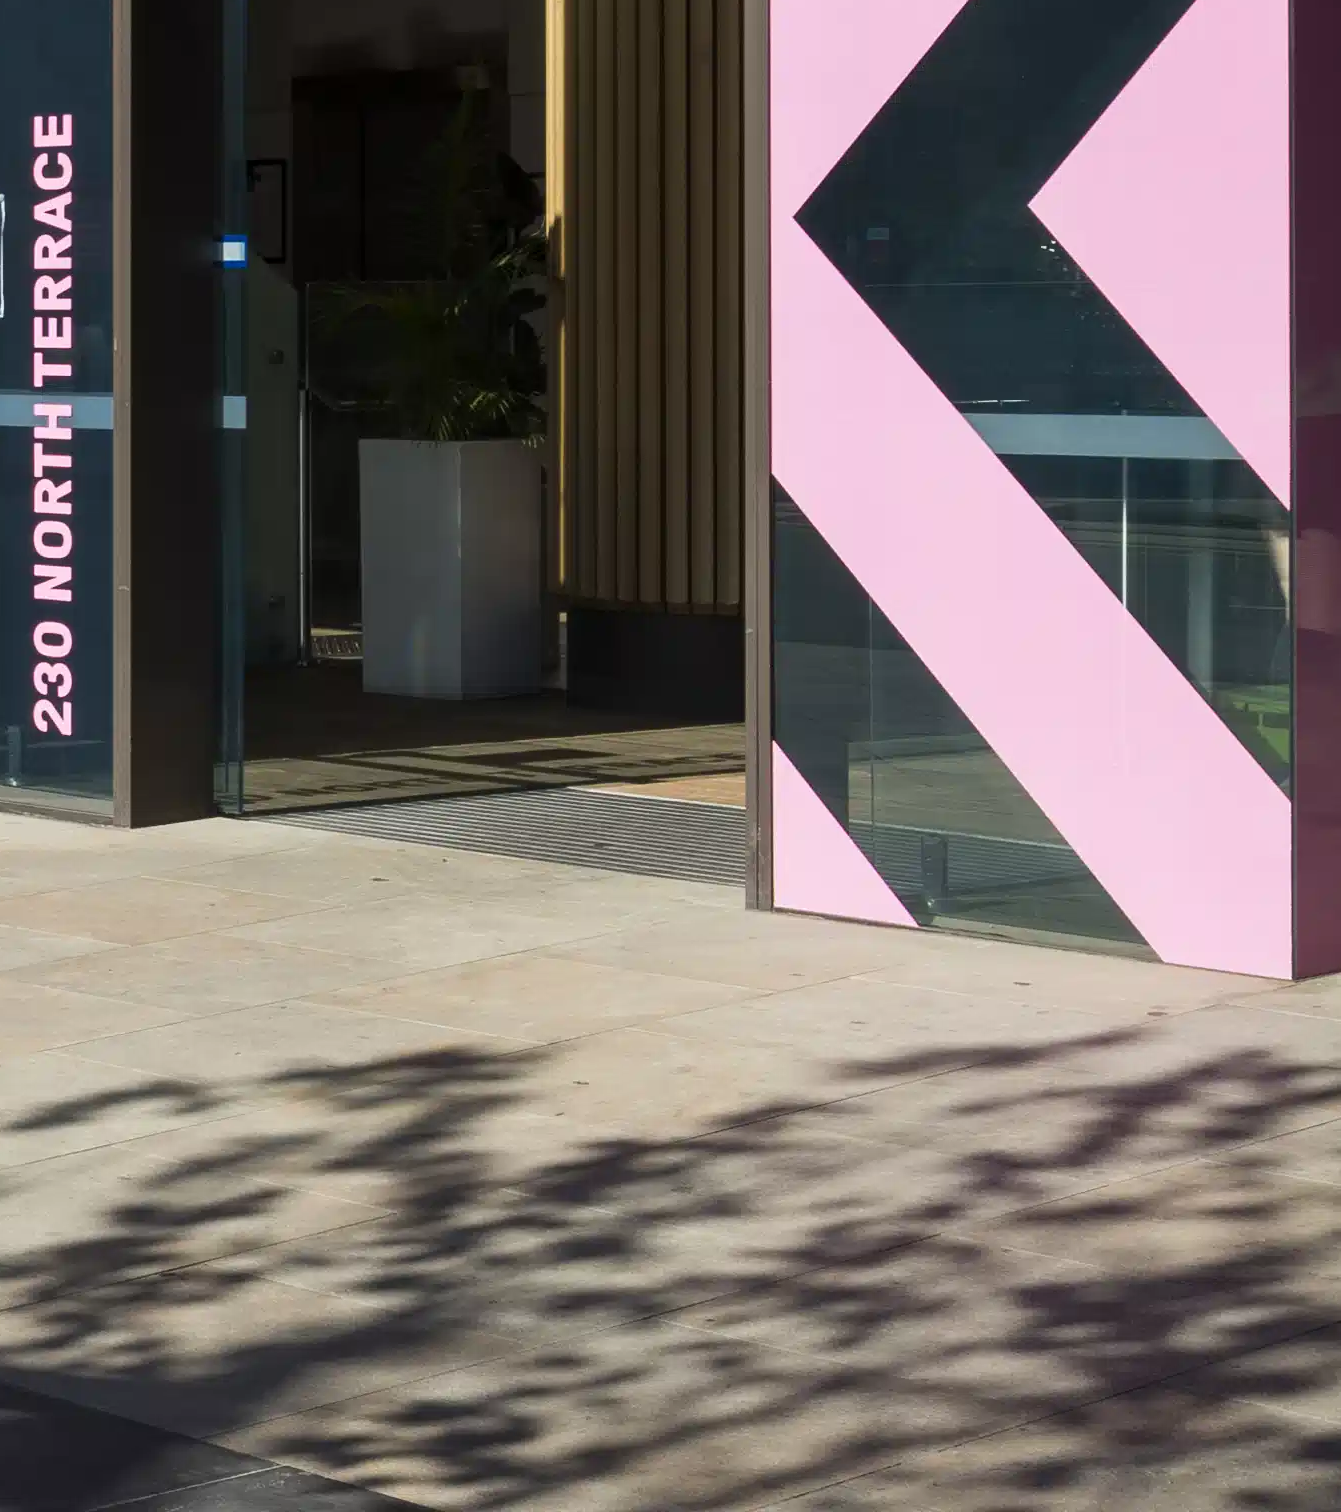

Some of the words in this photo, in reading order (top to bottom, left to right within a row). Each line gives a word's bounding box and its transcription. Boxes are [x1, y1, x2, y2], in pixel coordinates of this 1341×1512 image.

[33, 113, 73, 387] TERRACE
[33, 403, 73, 603] NORTH
[33, 621, 73, 736] 230
